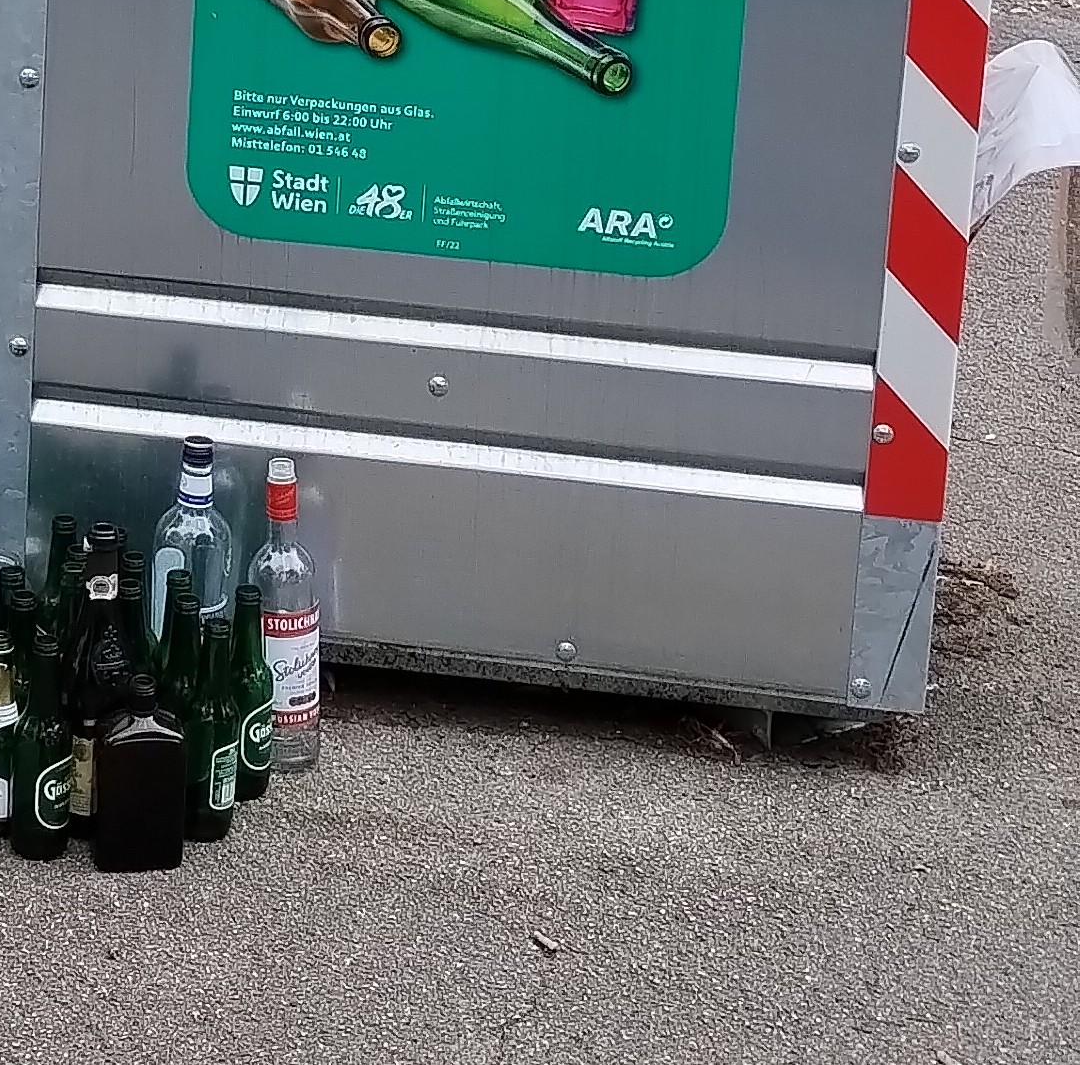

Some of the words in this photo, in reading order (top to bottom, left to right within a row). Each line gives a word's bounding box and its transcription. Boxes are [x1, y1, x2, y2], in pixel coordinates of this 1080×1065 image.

[234, 90, 263, 103] Bitte
[267, 94, 288, 105] nur
[290, 95, 377, 114] Verpackungen
[380, 105, 402, 116] aus
[404, 105, 435, 119] Glas.
[233, 105, 281, 120] Einwurf
[282, 110, 309, 122] 6:00
[313, 111, 330, 124] bis
[332, 114, 367, 128] 22:00
[370, 117, 393, 130] Uhr
[231, 122, 352, 143] www.abfall.wien.at
[231, 136, 306, 154] Misttelefon:
[308, 144, 324, 156] 01
[326, 145, 349, 158] 546
[351, 148, 367, 160] 48
[272, 169, 329, 193] Stadt
[271, 190, 327, 214] Wien
[578, 207, 657, 239] ARA
